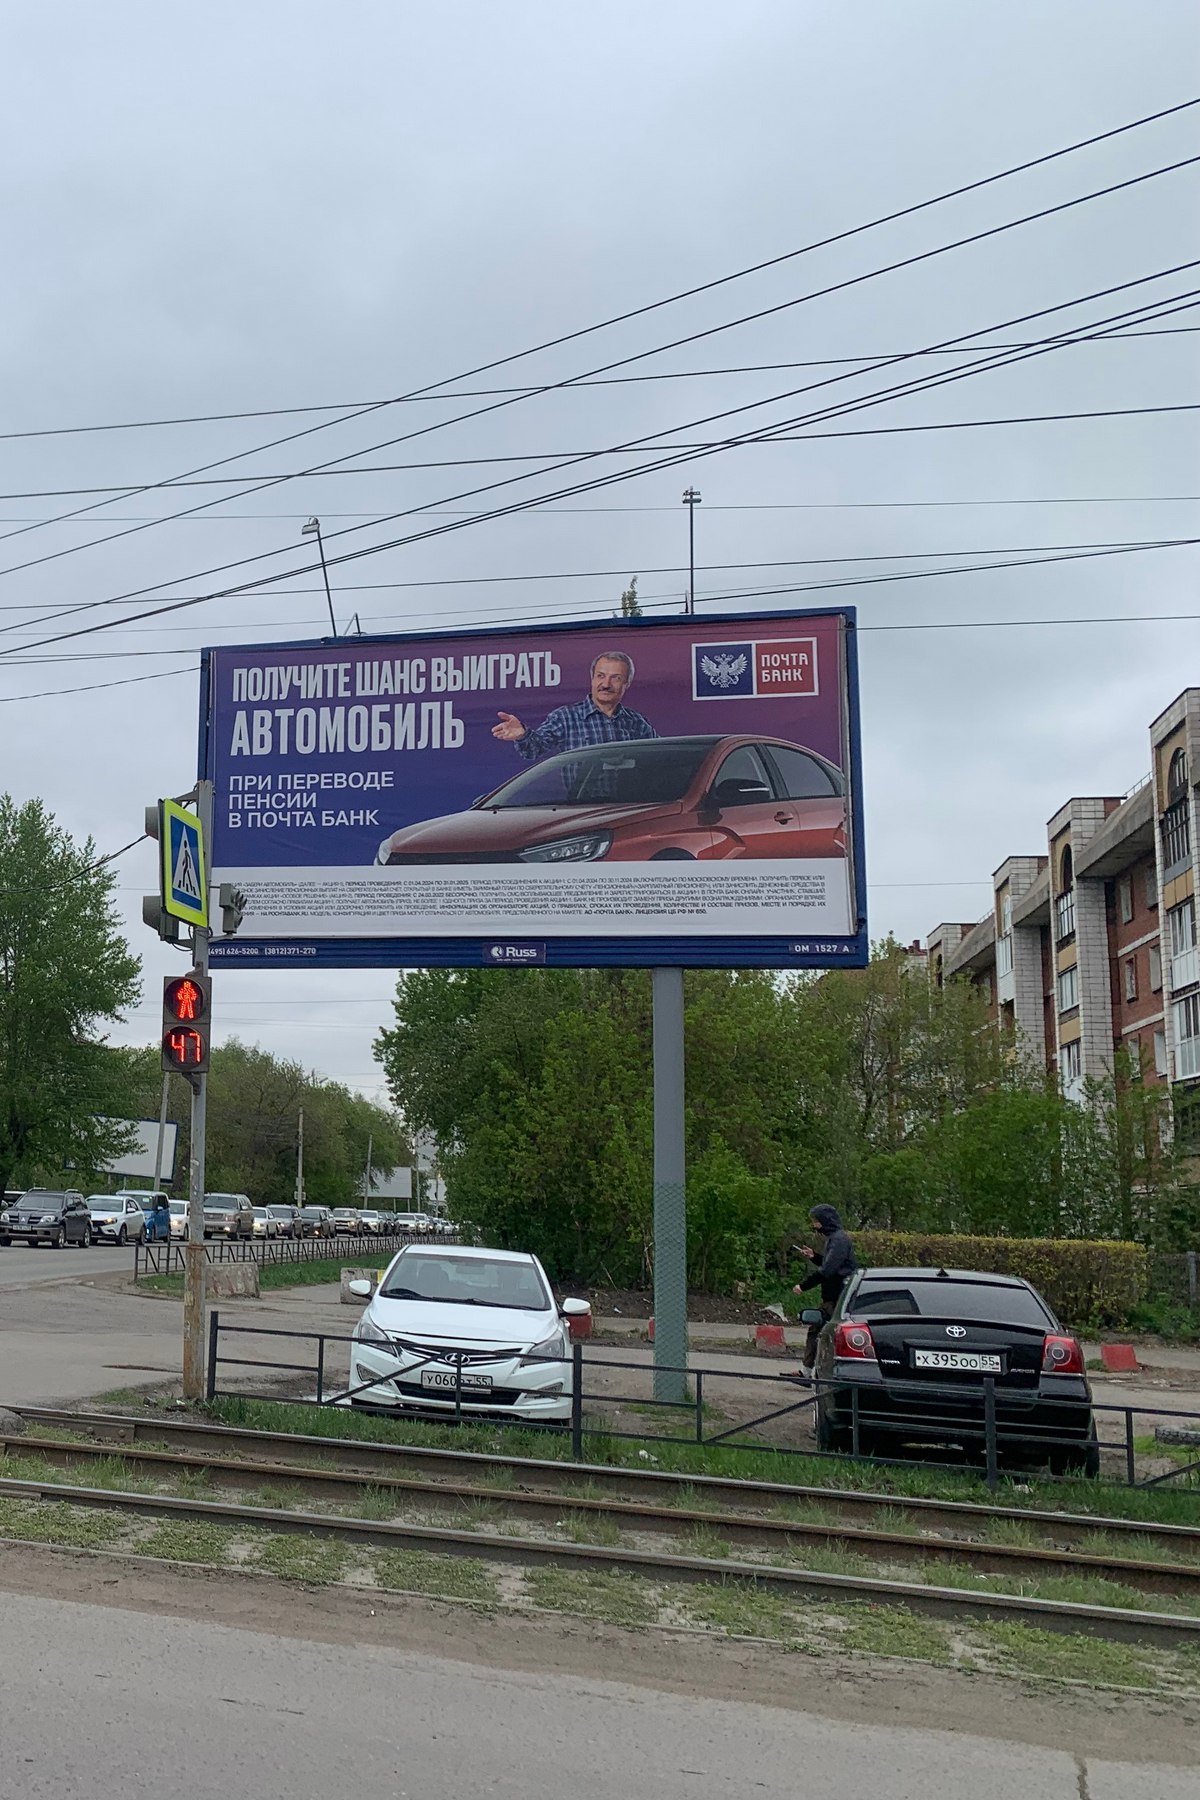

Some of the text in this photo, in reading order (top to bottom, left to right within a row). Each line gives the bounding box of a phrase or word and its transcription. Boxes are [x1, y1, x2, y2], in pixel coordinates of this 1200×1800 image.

[761, 653, 809, 667] ПОЧТА
[232, 651, 561, 702] ПОЛУЧИТЕ ШАНС ВЫИГРАТЬ
[762, 668, 803, 683] БАНК
[230, 700, 465, 756] АВТОМОБИЛЬ
[229, 771, 394, 791] ПРИ ПЕРЕВОДЕ
[229, 792, 317, 810] ПЕНСИИ
[228, 809, 380, 828] В ПОЧТА БАНК
[506, 947, 537, 957] Russ
[815, 944, 838, 953] 1527
[171, 1032, 201, 1063] 47
